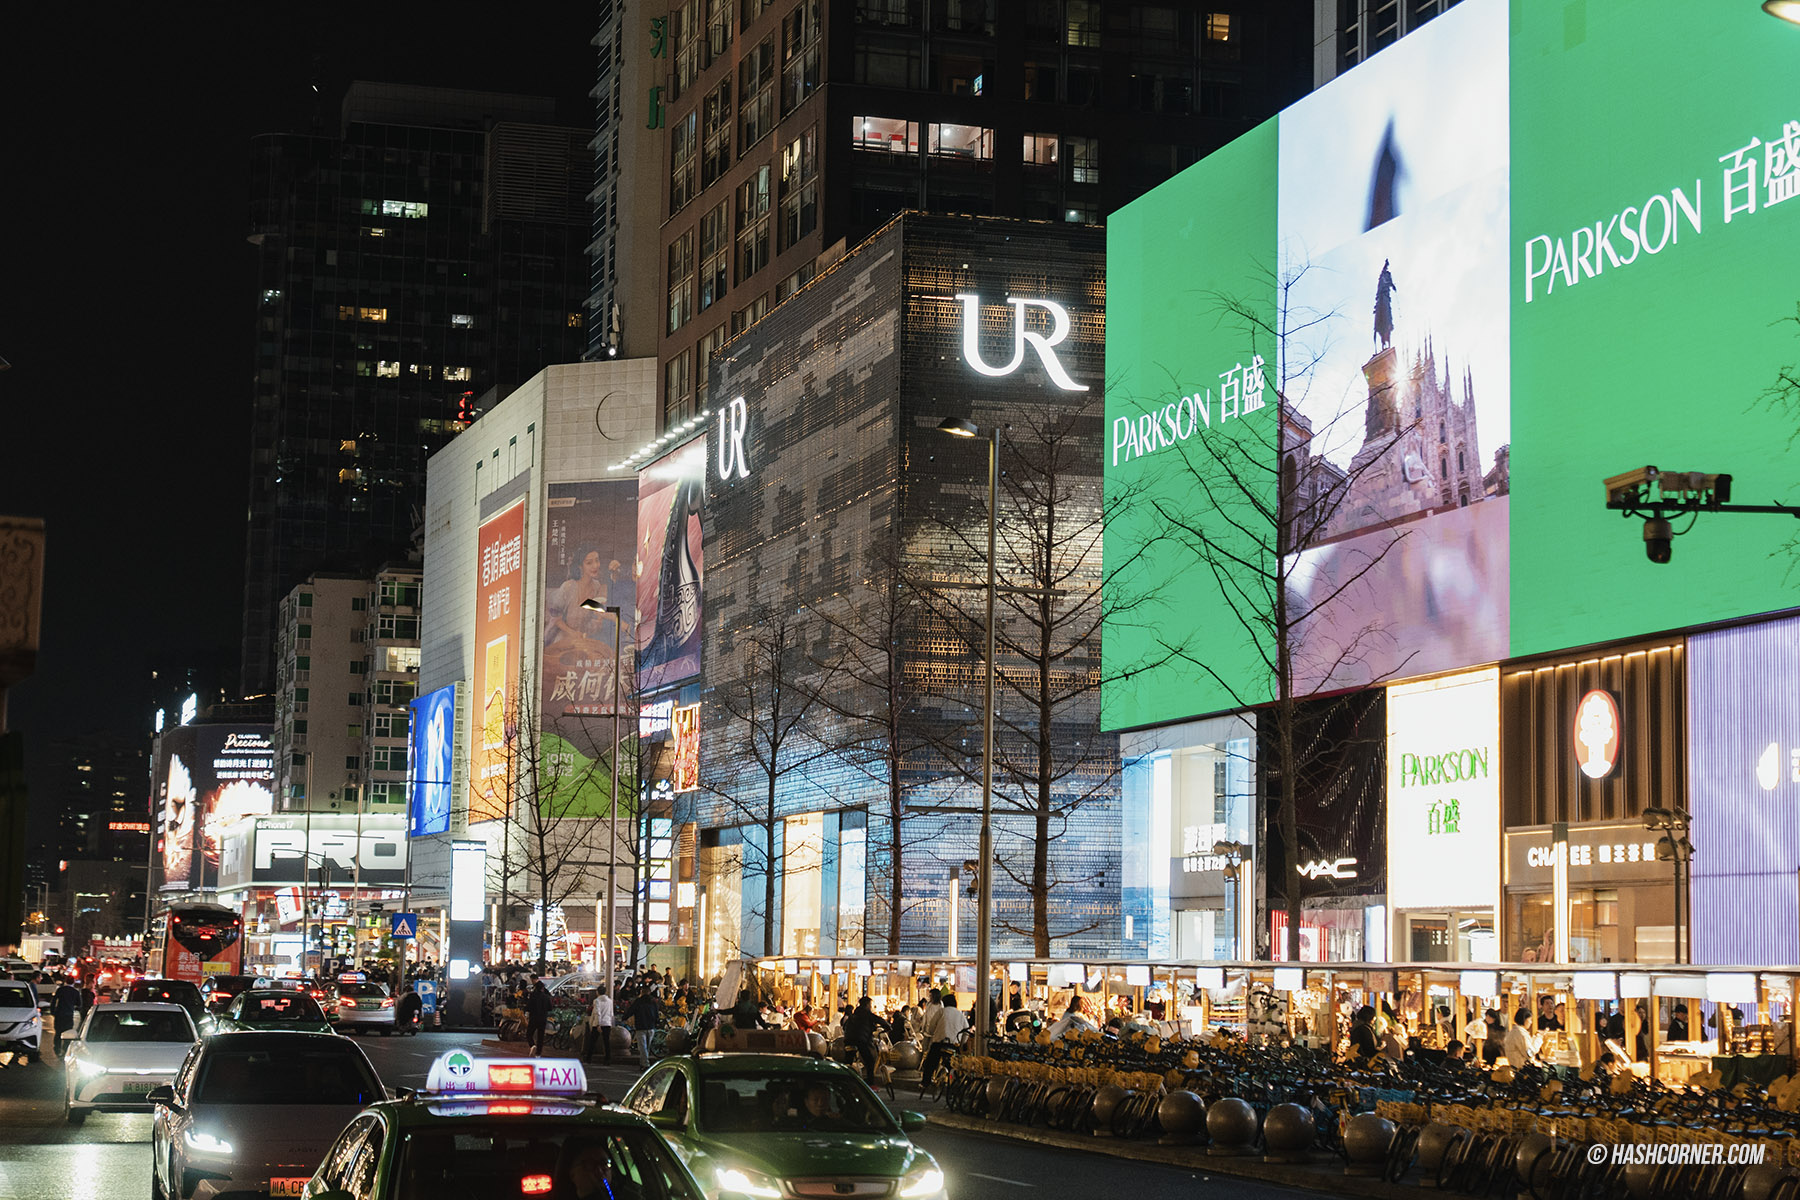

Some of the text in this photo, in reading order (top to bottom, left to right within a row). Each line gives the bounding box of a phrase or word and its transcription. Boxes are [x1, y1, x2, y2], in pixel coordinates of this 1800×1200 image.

[1525, 119, 1800, 303] PARKSON 百盛
[955, 293, 1090, 392] UR
[1112, 354, 1266, 467] PARKSON 百盛
[718, 396, 751, 481] UR
[224, 733, 271, 749] Precious
[1400, 746, 1489, 789] PARKSON
[262, 820, 286, 829] iPhone
[1425, 798, 1461, 835] 百盛
[255, 829, 407, 869] PRO
[417, 981, 434, 1000] P
[538, 1067, 577, 1086] TAXI
